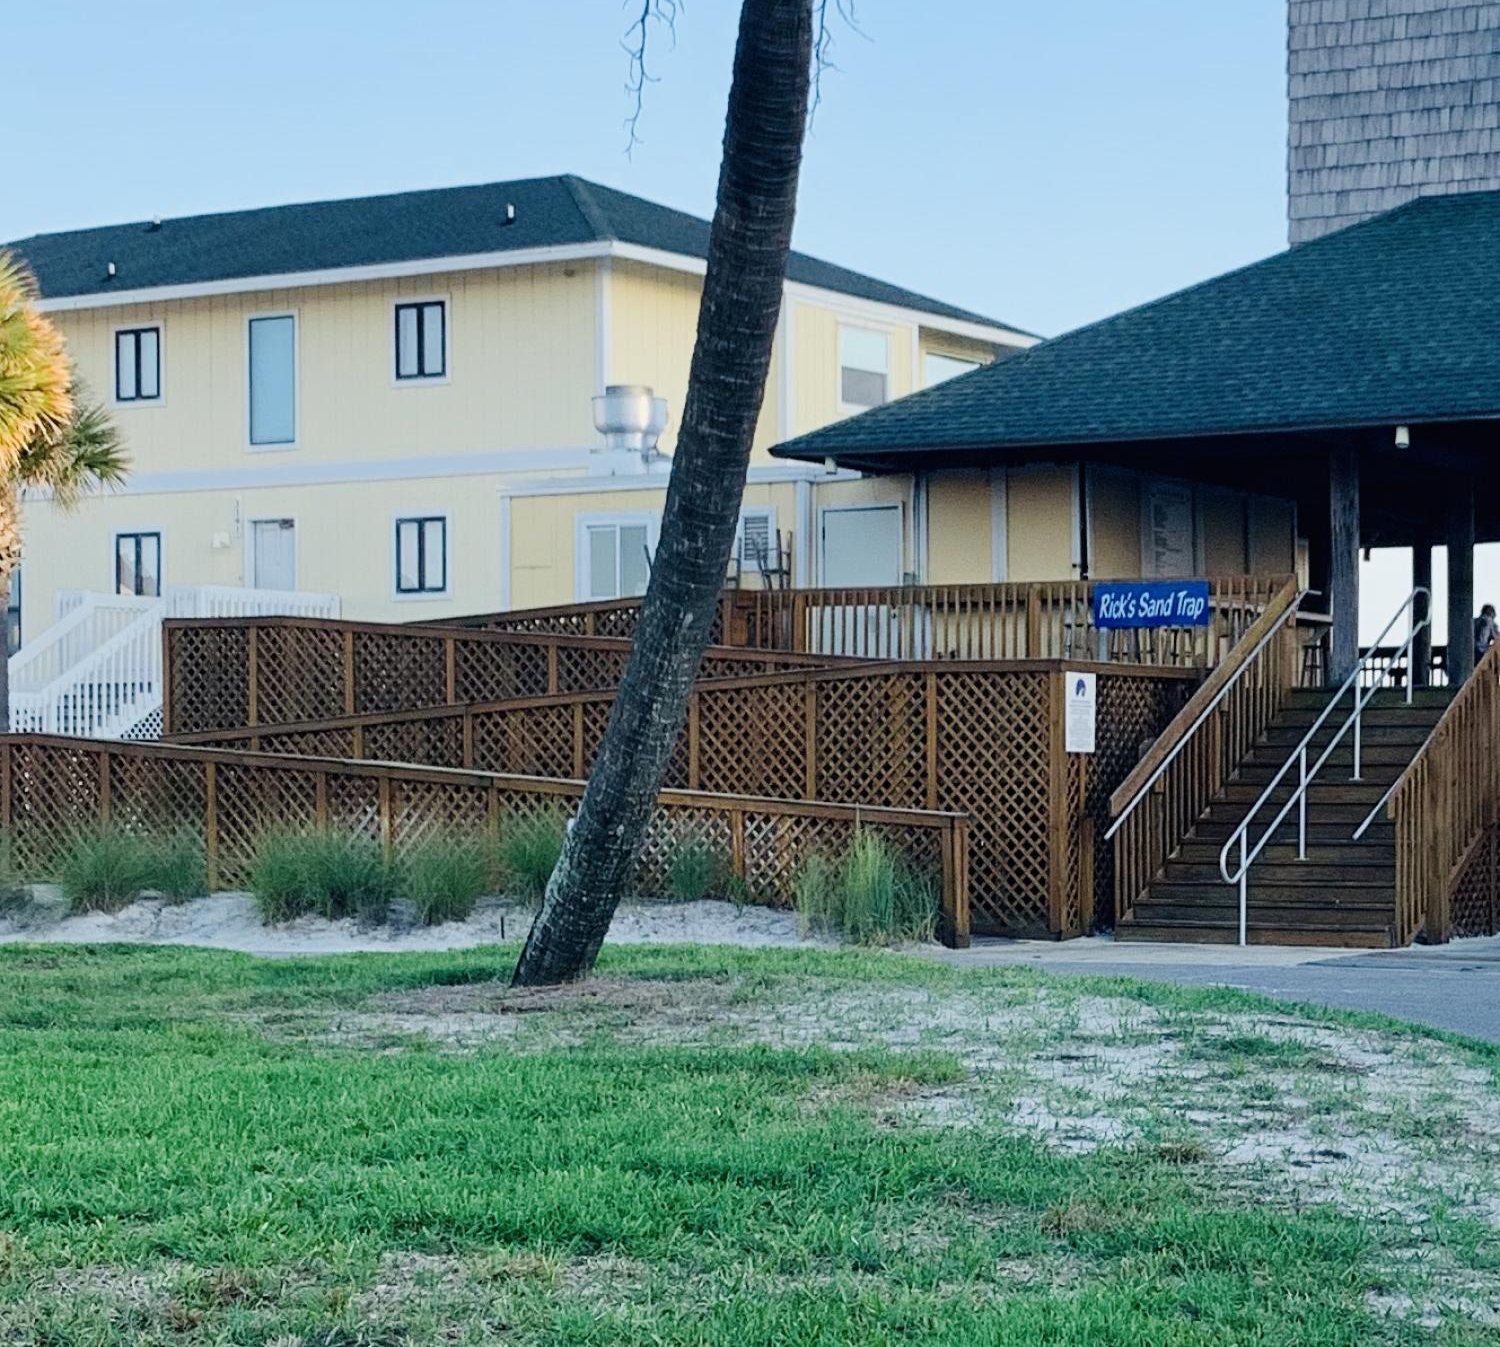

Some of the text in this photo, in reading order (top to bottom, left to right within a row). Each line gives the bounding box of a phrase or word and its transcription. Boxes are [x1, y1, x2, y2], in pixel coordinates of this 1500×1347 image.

[1099, 591, 1204, 620] Rick's Sand Trap
